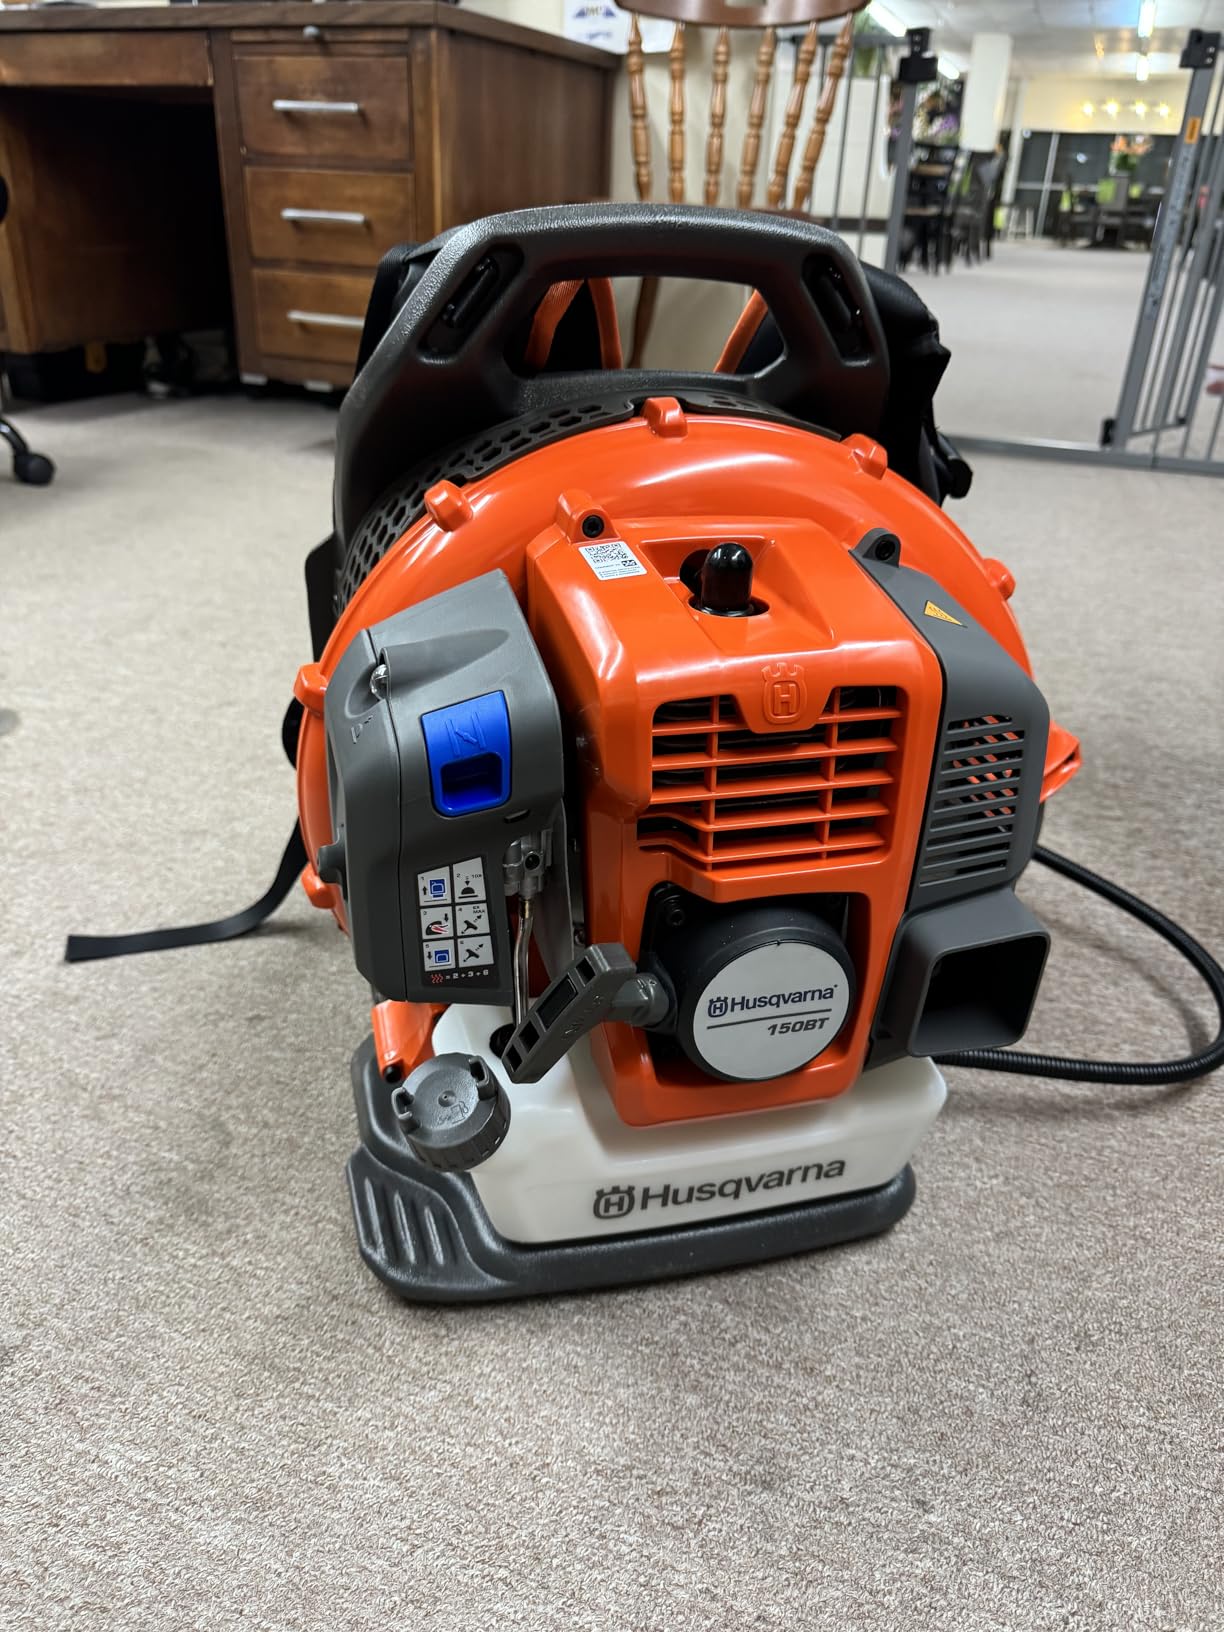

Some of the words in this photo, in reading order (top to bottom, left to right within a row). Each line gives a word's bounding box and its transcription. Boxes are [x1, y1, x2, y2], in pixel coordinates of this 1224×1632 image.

[730, 986, 834, 1012] Husqvarna
[767, 1017, 830, 1036] 150BT
[640, 1159, 846, 1211] Husqvarna
